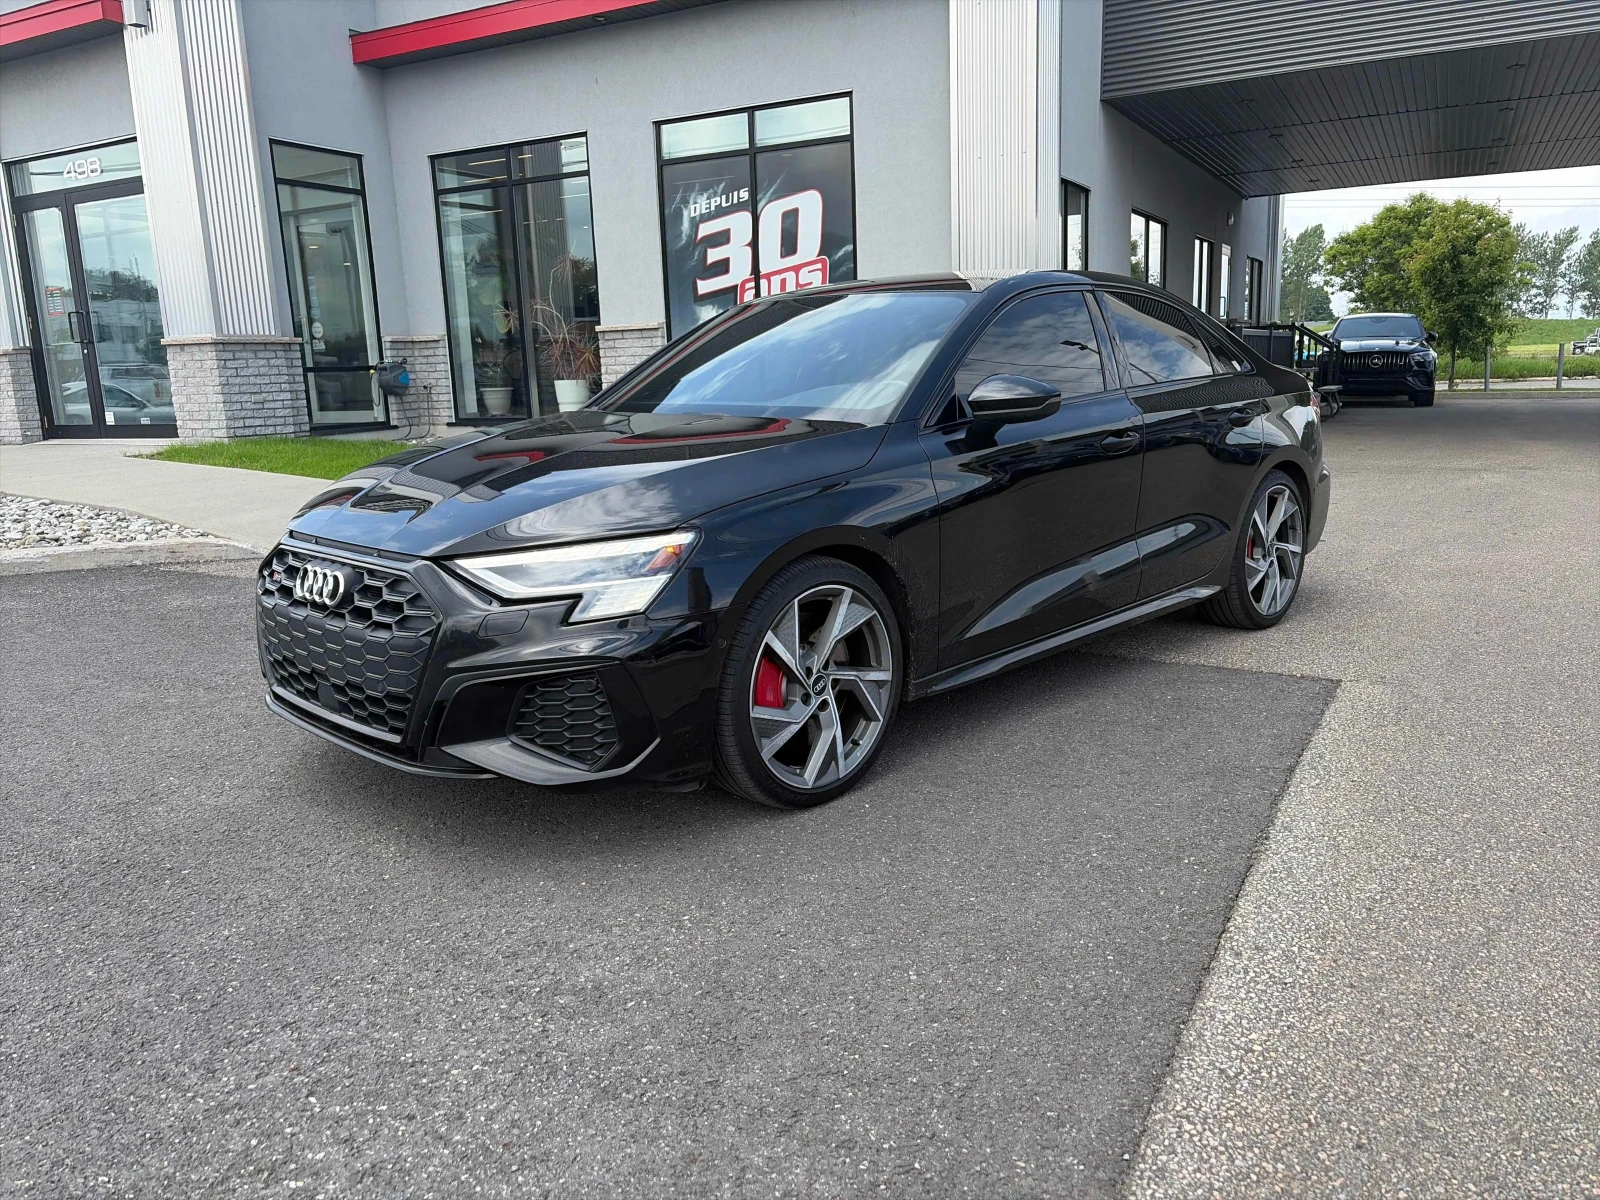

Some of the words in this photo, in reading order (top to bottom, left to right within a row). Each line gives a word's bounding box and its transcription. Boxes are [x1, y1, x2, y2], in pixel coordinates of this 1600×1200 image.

[63, 157, 101, 180] 498
[690, 187, 749, 217] DEPUIS
[696, 189, 823, 296] 30
